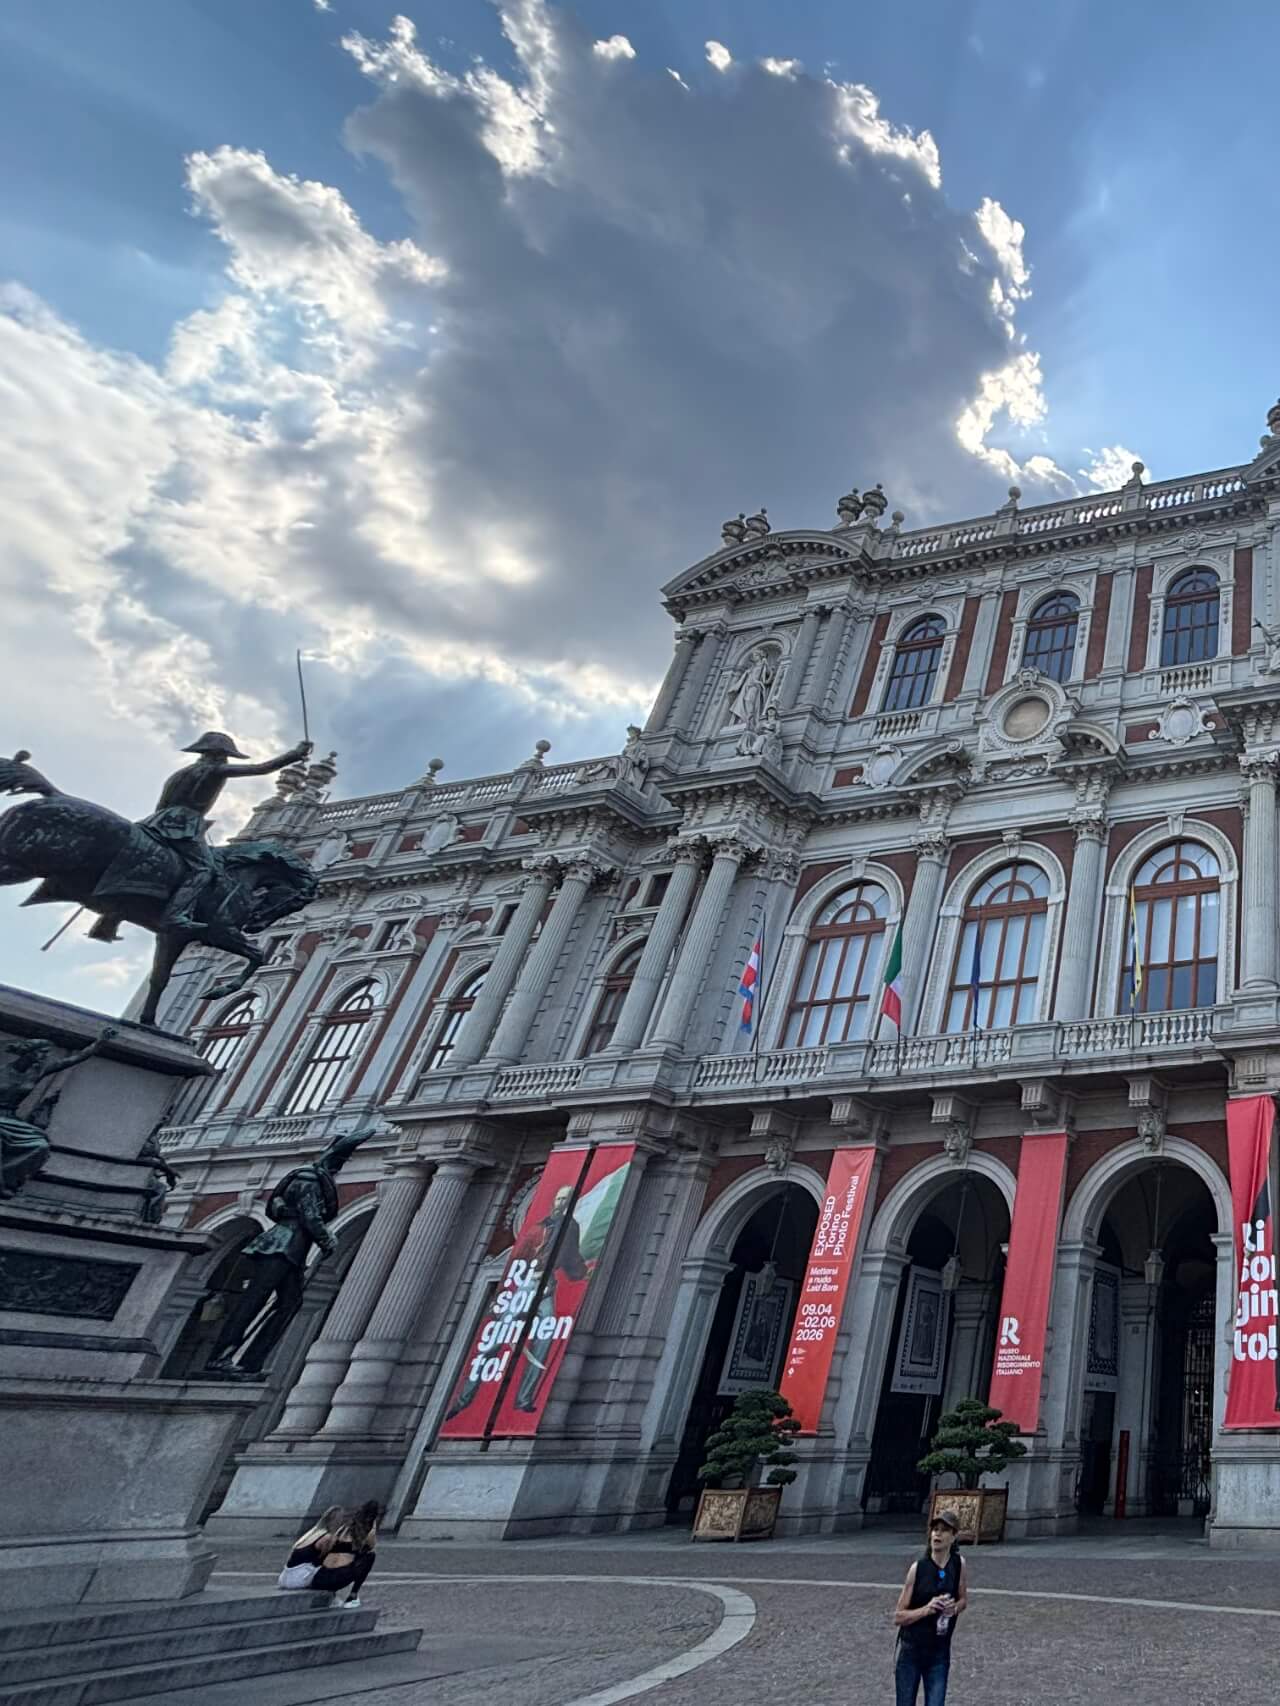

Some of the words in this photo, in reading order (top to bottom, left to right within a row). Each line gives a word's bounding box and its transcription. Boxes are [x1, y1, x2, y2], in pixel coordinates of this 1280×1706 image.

[832, 1220, 849, 1256] Photo
[841, 1175, 860, 1218] Festival
[814, 1195, 836, 1256] EXPOSED
[824, 1213, 841, 1251] Torino
[814, 1276, 832, 1284] nudo
[821, 1284, 839, 1292] Bare
[802, 1304, 833, 1316] 09.04
[795, 1329, 824, 1341] 2026
[1233, 1324, 1279, 1361] to!
[469, 1350, 511, 1382] to!
[997, 1361, 1041, 1369] RISORGIMENTO
[996, 1368, 1024, 1376] ITALIANO
